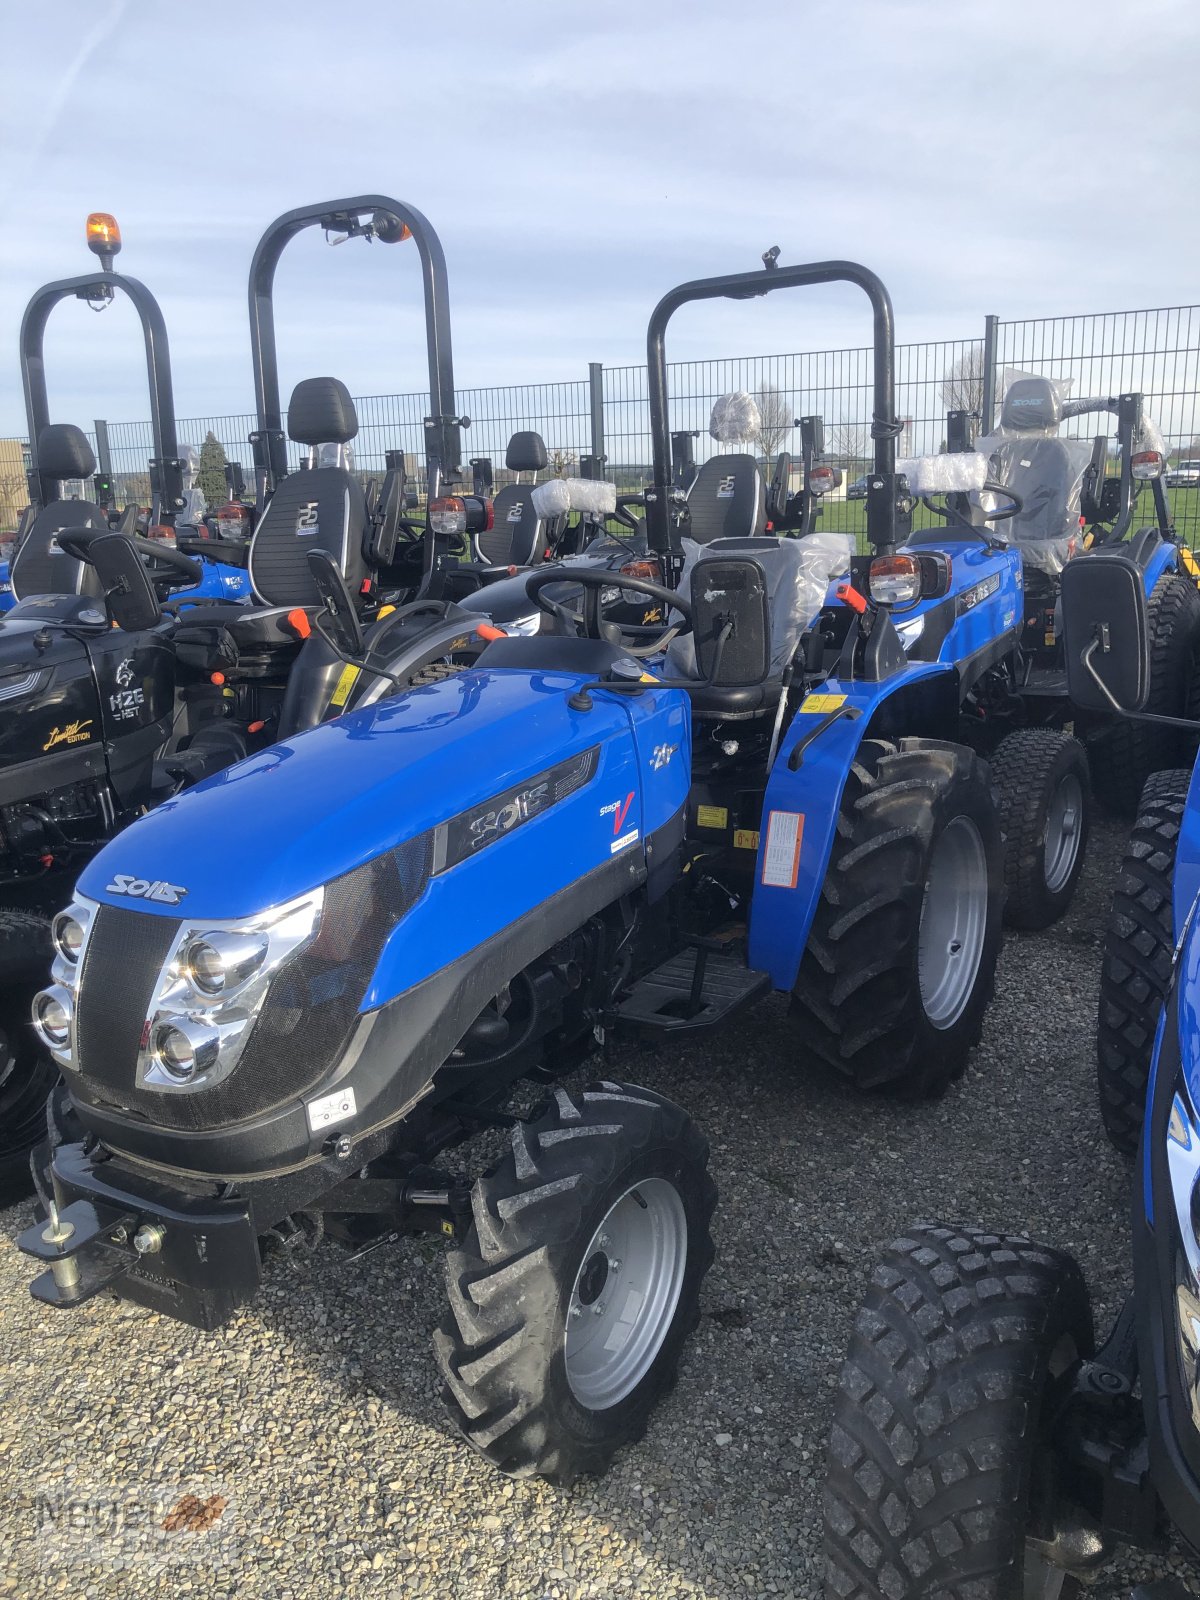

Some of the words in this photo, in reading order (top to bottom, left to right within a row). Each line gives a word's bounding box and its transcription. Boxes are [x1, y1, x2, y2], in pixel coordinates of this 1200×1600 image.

[121, 706, 140, 720] HST
[43, 720, 93, 751] Limited
[67, 732, 91, 744] EDITION
[600, 800, 621, 817] Stage
[614, 791, 635, 835] V
